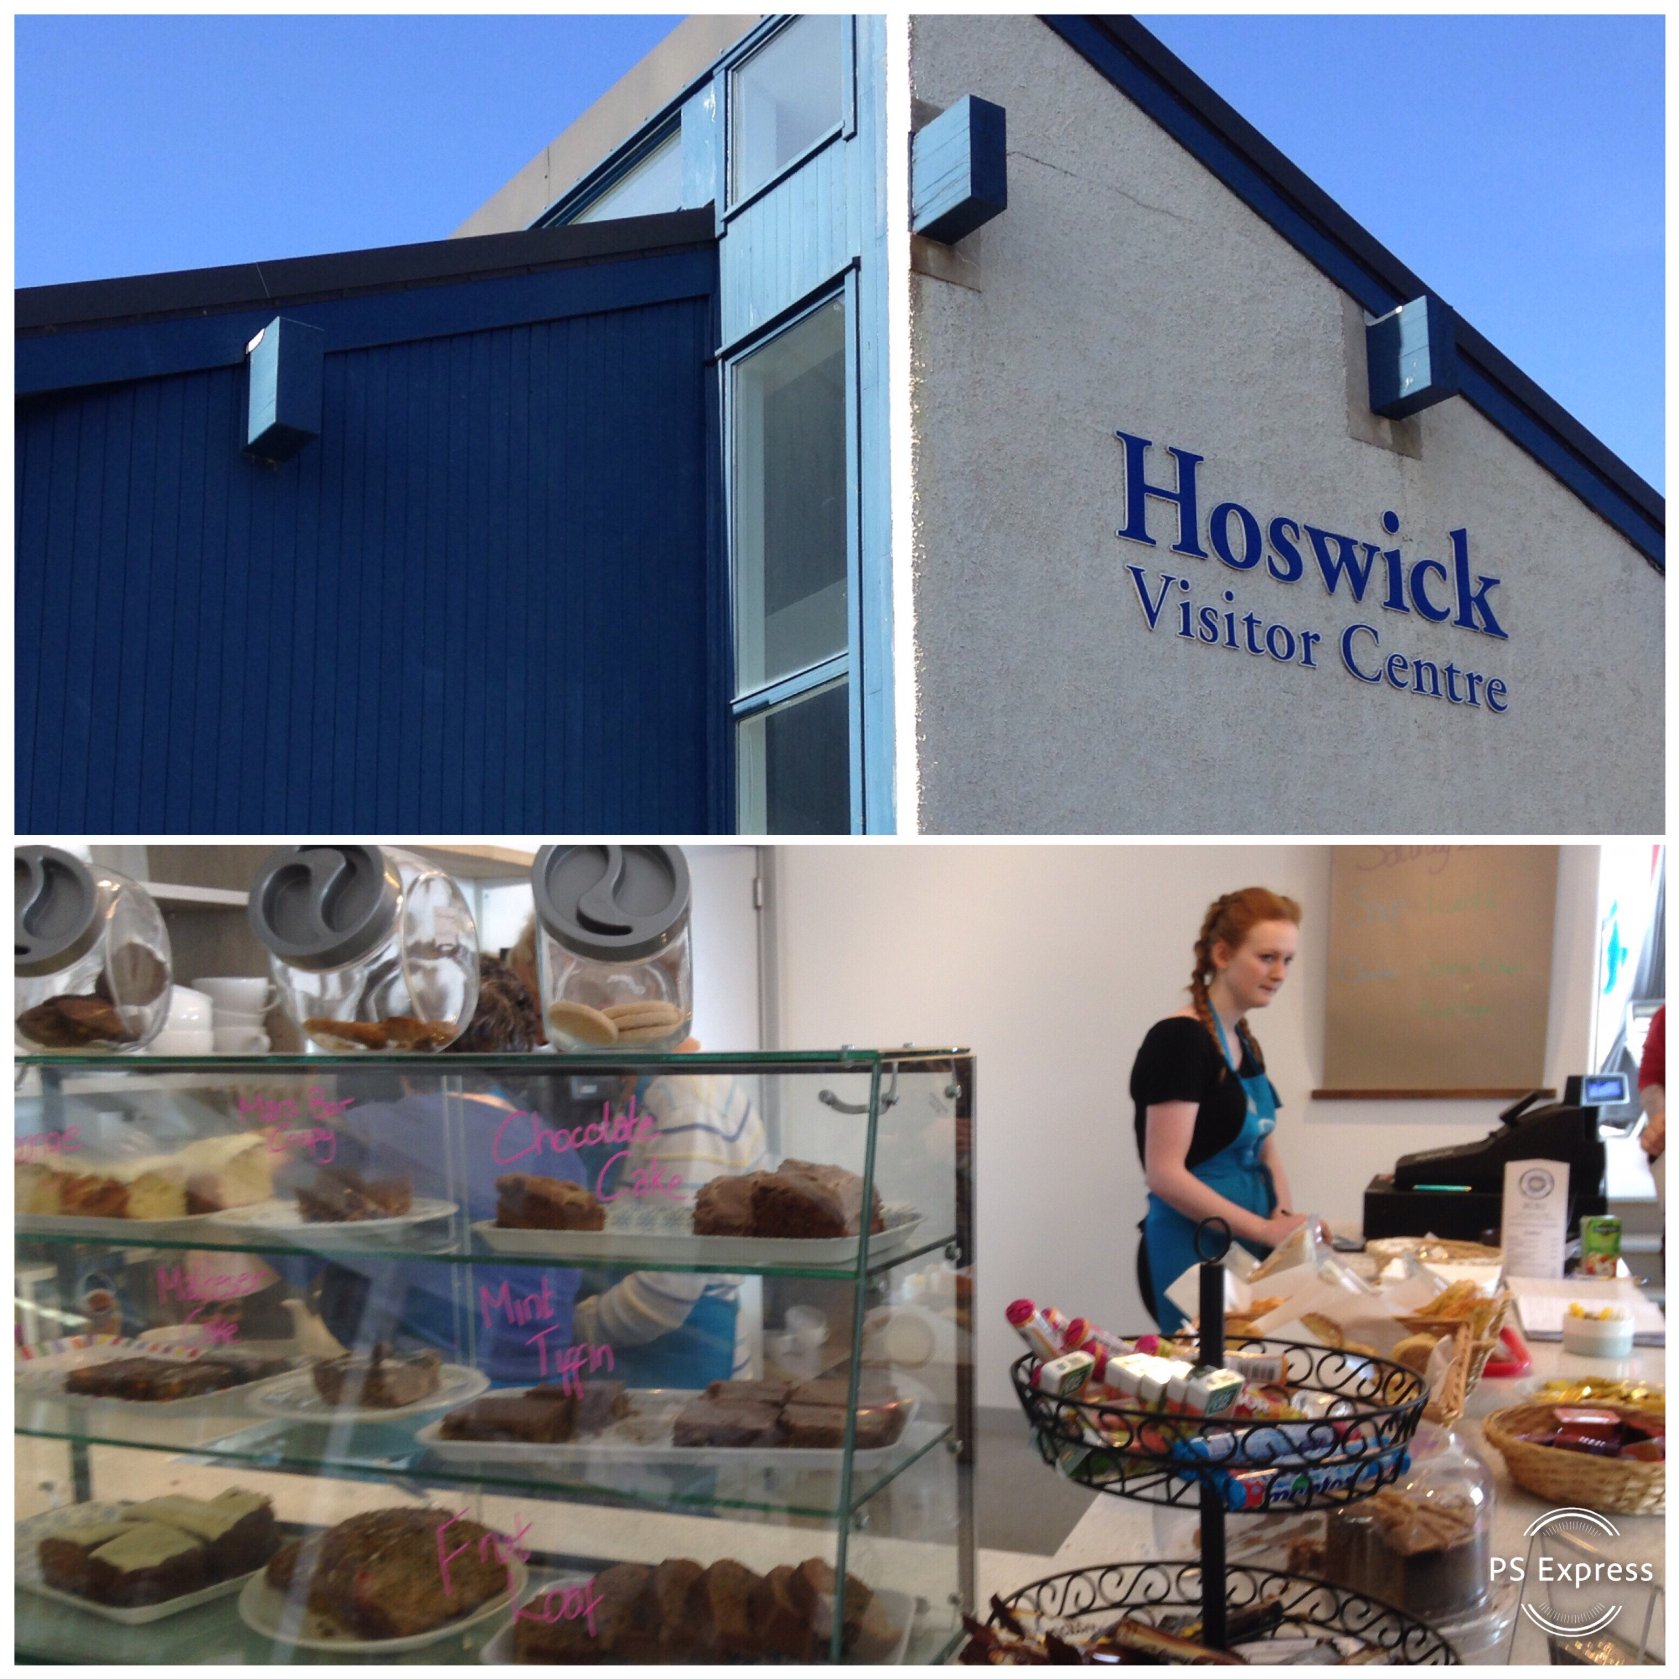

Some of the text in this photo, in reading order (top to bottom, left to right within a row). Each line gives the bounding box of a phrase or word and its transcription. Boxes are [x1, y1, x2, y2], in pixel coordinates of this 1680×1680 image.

[1115, 430, 1509, 639] Hoswick
[1126, 564, 1508, 713] Visitor Centre
[492, 1095, 662, 1164] Chocolate
[596, 1151, 688, 1201] Cake
[479, 1275, 556, 1328] Mint
[507, 1568, 605, 1638] Loaf
